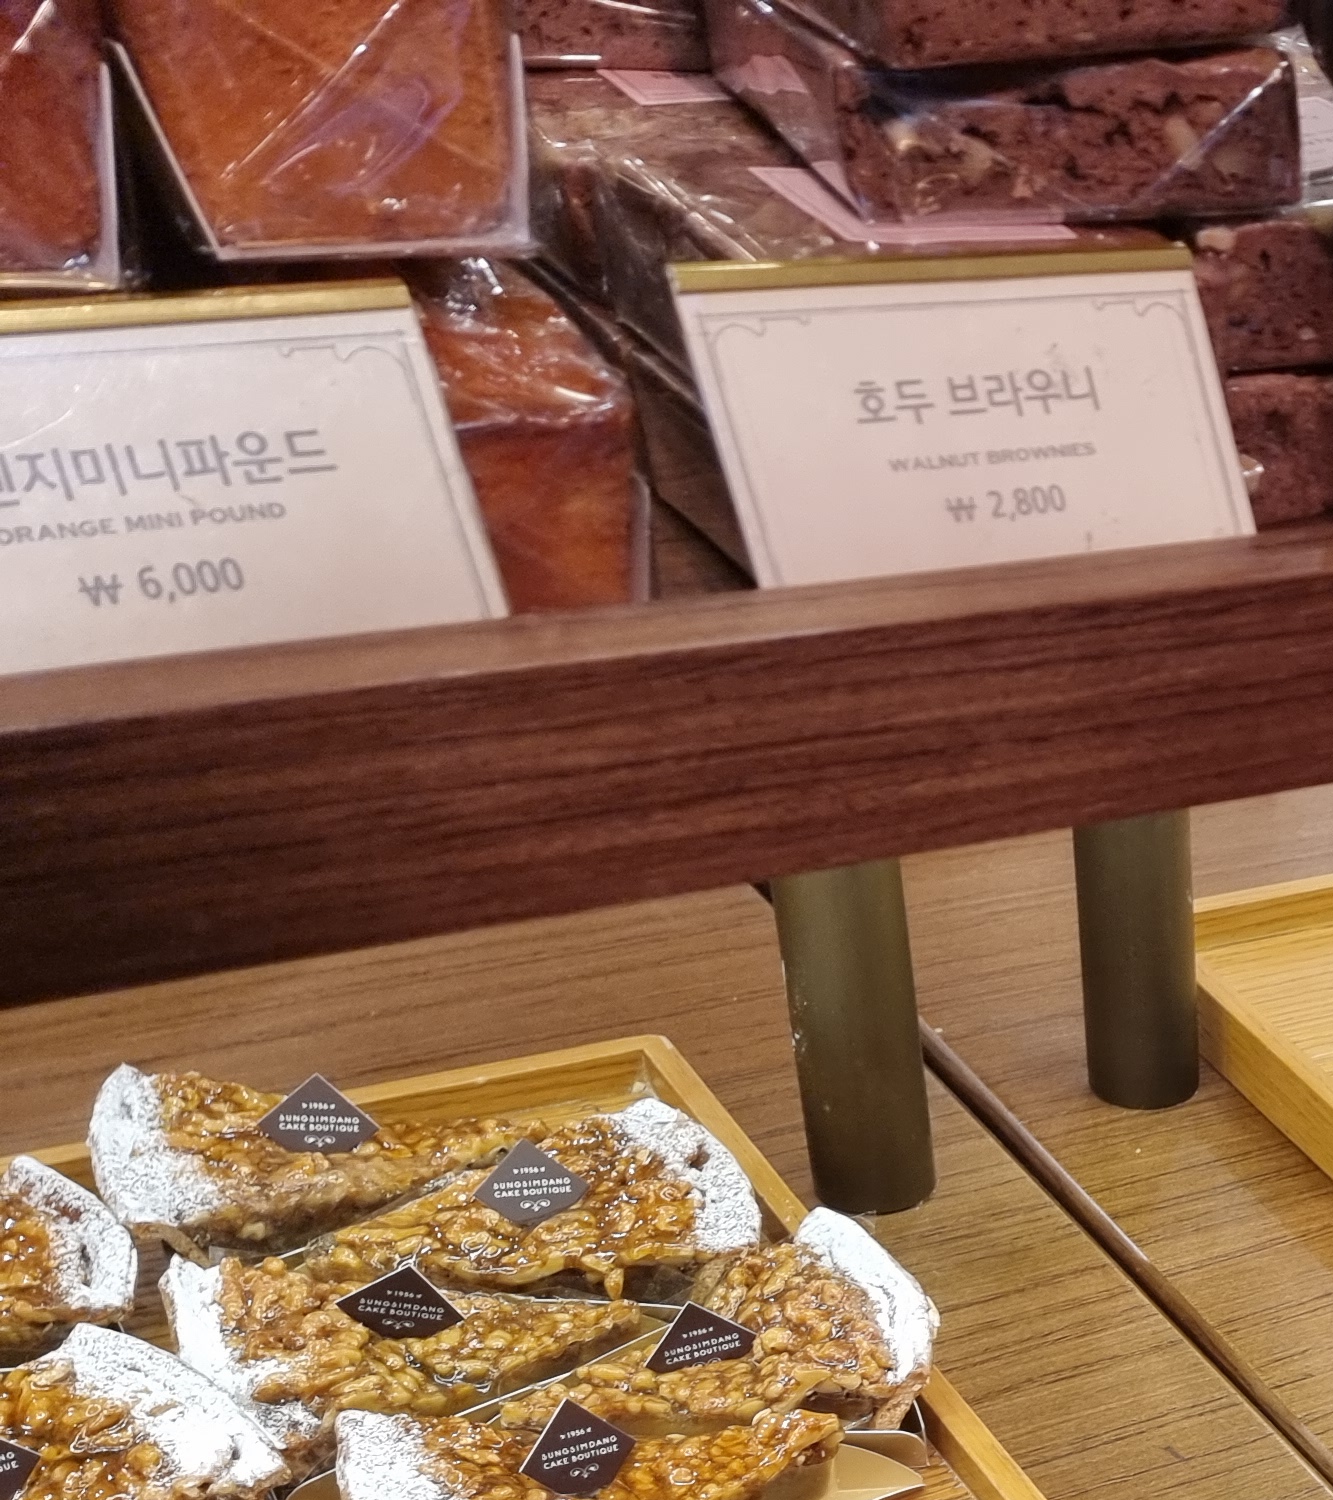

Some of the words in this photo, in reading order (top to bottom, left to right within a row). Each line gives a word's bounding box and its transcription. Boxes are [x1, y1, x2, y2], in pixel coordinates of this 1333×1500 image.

[853, 379, 936, 425] 호두
[946, 365, 1101, 418] 브라우니
[889, 450, 980, 474] WALNUT
[985, 441, 1097, 465] BROWNIES
[990, 484, 1067, 523] 2,800
[0, 517, 112, 547] ORANGE
[124, 511, 183, 533] MINI
[192, 501, 287, 528] POUND
[136, 556, 245, 605] 6,000
[279, 1122, 306, 1131] CAKE
[308, 1123, 360, 1133] BOUTIQUE
[493, 1189, 521, 1199] CAKE
[522, 1185, 572, 1197] BOUTIQUE
[357, 1305, 386, 1314] CAKE
[389, 1308, 443, 1321] BOUTIQUE
[665, 1353, 692, 1365] CAKE
[693, 1340, 742, 1358] BOUTIQUE
[566, 1429, 586, 1439] 1956
[543, 1457, 570, 1470] CAKE
[571, 1443, 620, 1463] BOUTIQUE
